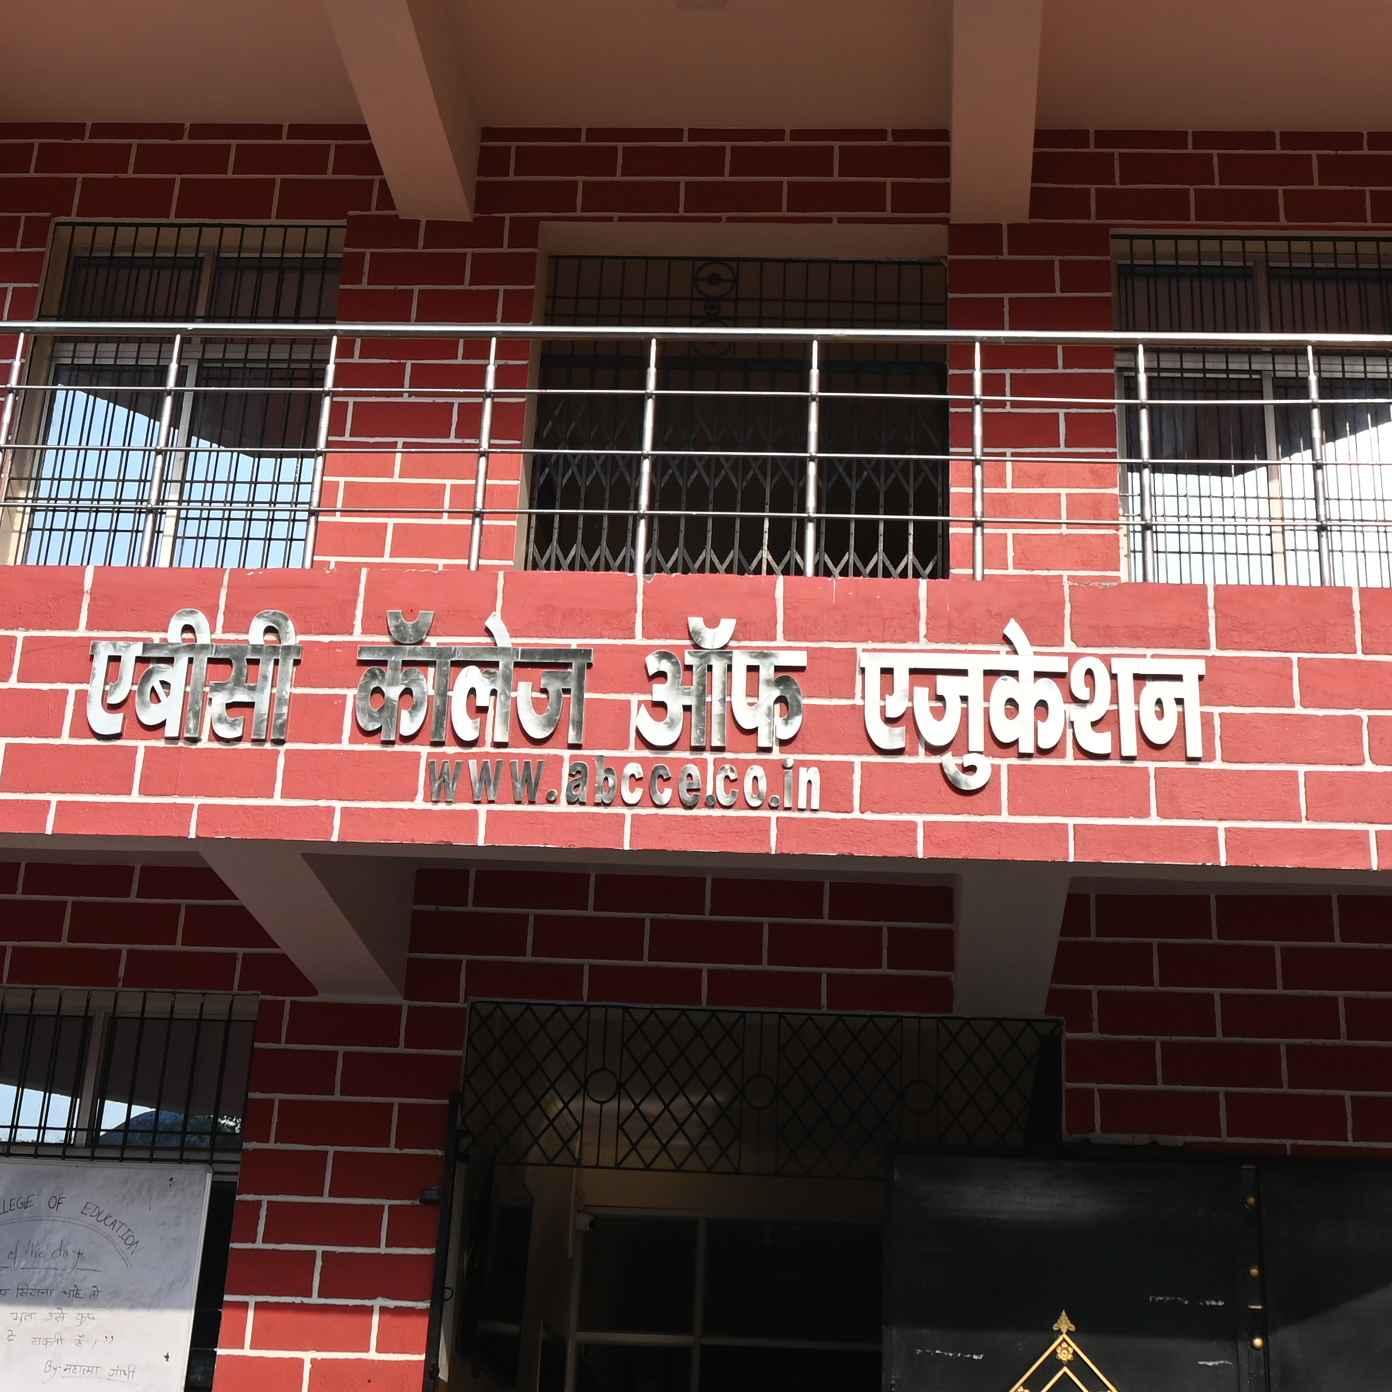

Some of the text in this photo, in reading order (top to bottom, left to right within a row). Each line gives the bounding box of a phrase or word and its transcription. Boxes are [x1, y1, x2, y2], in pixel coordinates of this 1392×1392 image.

[86, 608, 1206, 791] एबीसी कॉलेज ऑफ एजुकेशन
[47, 1195, 67, 1212] OF
[80, 1201, 141, 1256] EDUCATION
